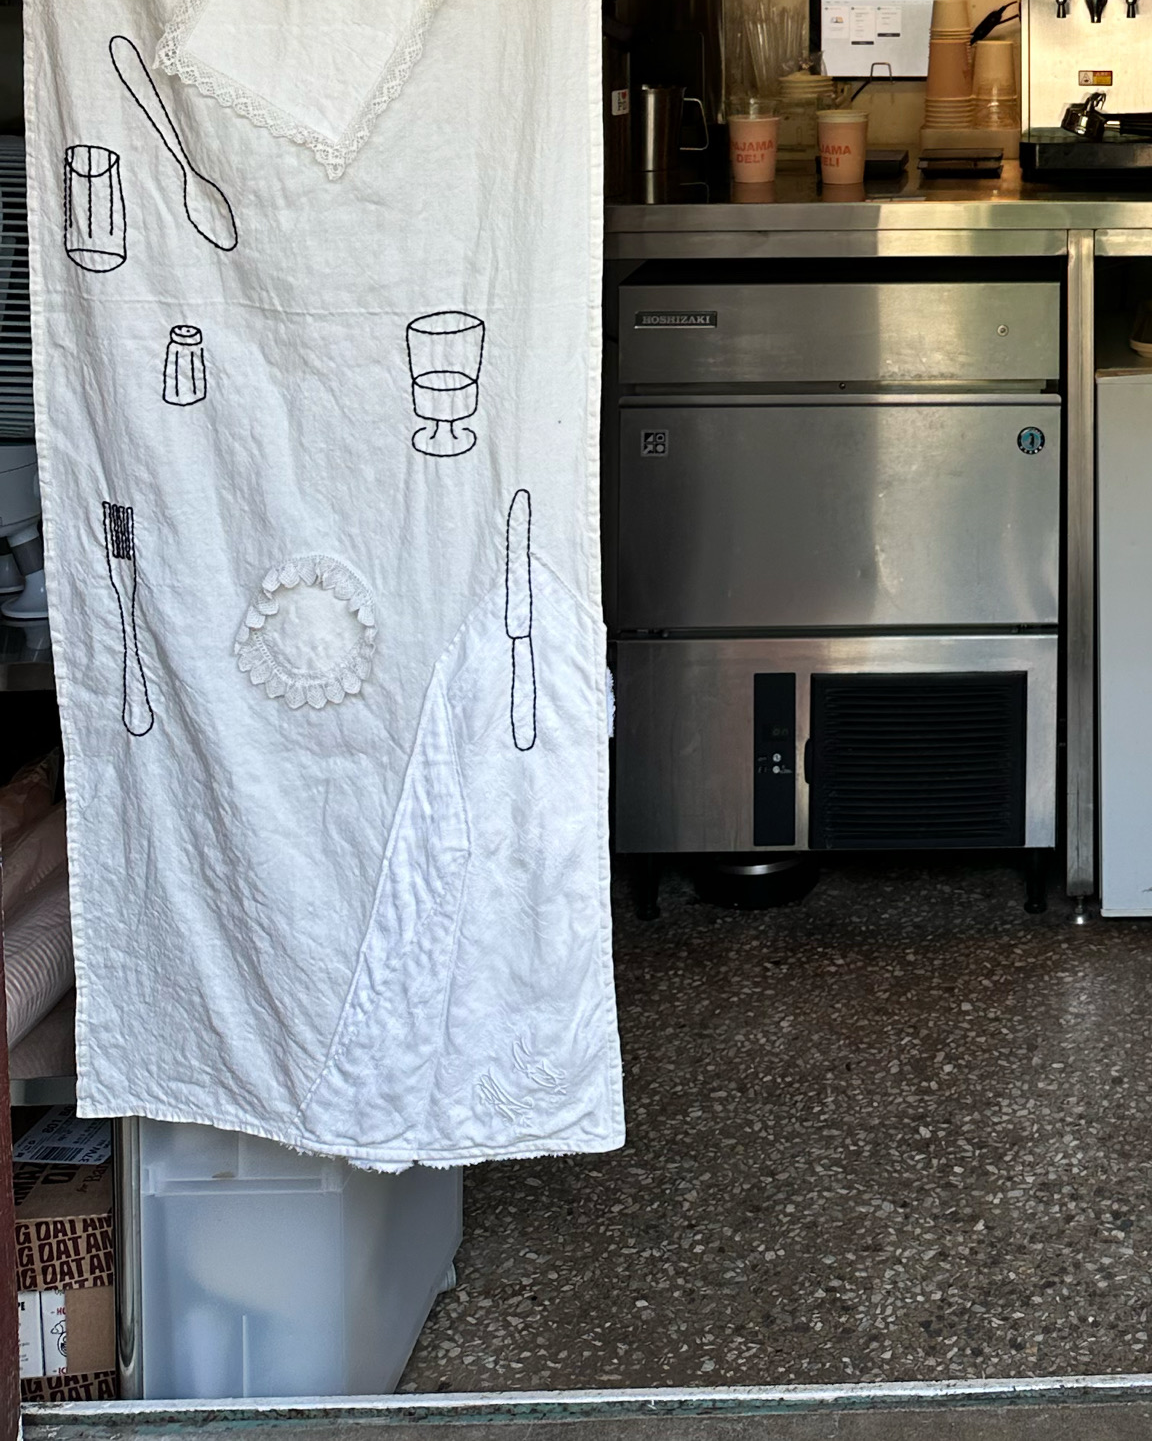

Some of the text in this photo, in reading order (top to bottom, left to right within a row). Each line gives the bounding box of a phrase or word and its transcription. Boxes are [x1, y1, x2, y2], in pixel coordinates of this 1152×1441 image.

[736, 153, 765, 163] DELI
[822, 156, 840, 167] ELI
[642, 315, 711, 324] HOSHIZAKI
